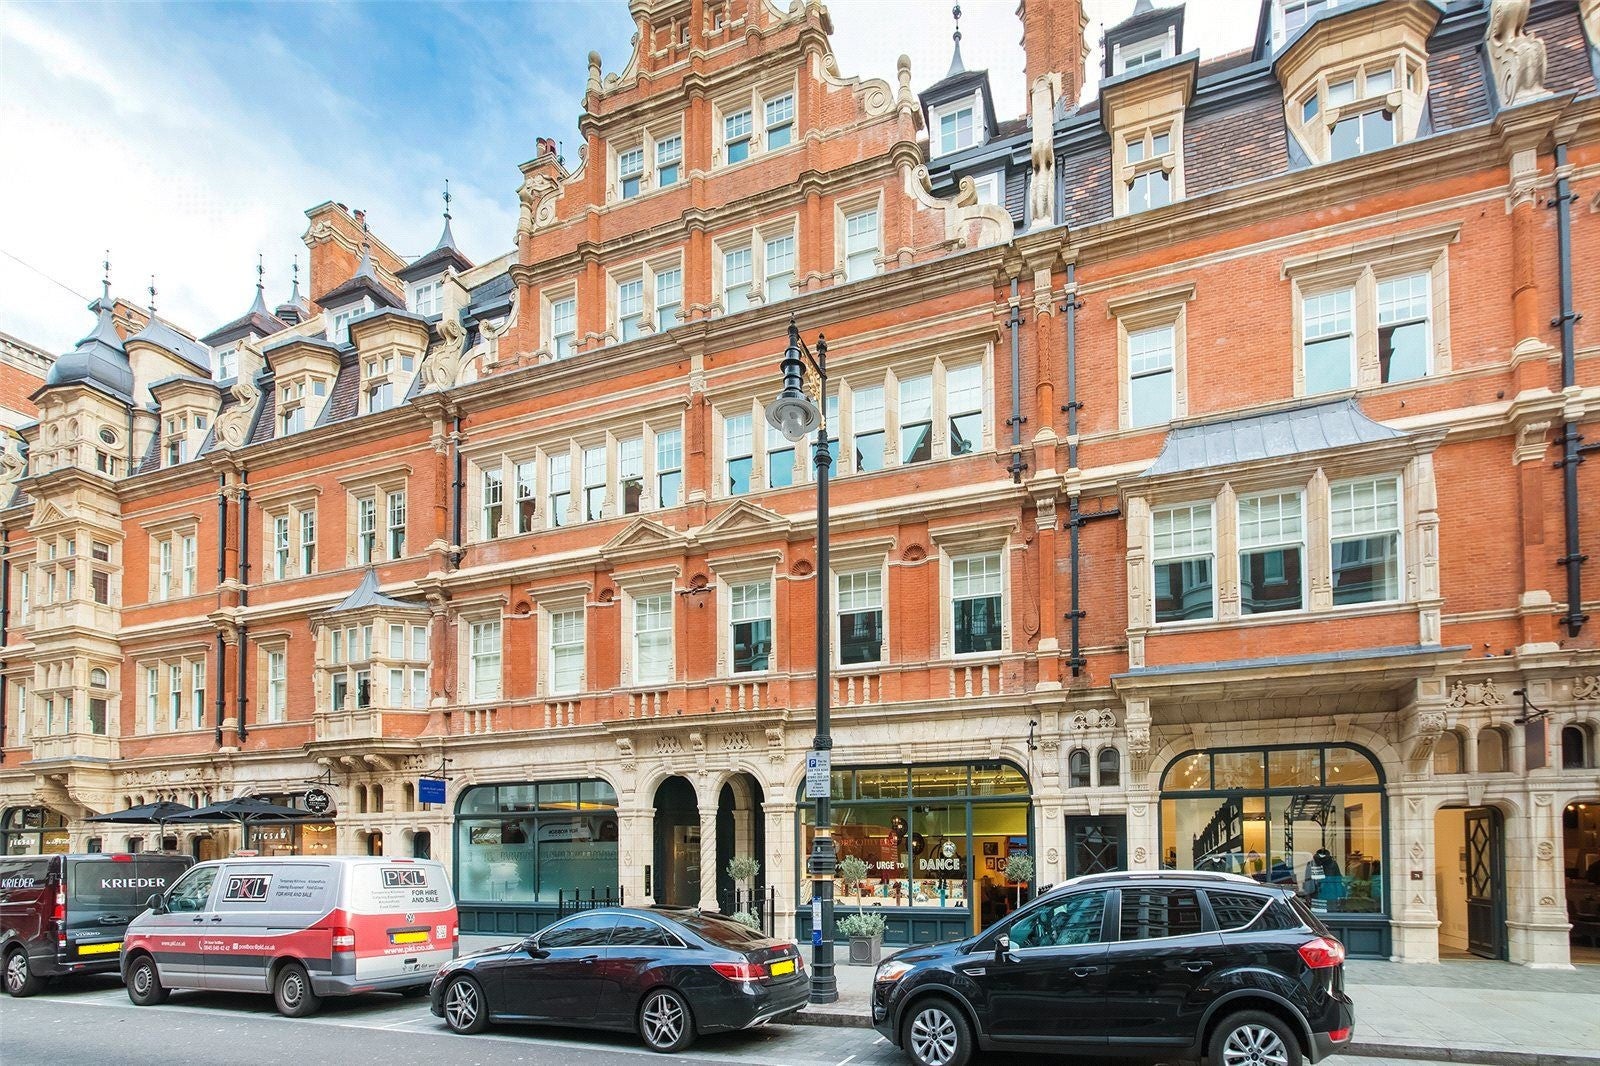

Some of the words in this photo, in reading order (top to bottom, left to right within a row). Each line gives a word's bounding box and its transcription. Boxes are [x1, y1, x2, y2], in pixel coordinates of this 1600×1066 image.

[252, 832, 286, 841] JIGSAW
[876, 861, 895, 870] URGE
[919, 859, 960, 870] DANCE
[1, 877, 35, 888] KRIEDER
[101, 877, 165, 889] KRIEDER
[384, 871, 425, 886] PKL
[226, 878, 267, 898] PKL
[384, 945, 435, 955] www.pkl.co.uk
